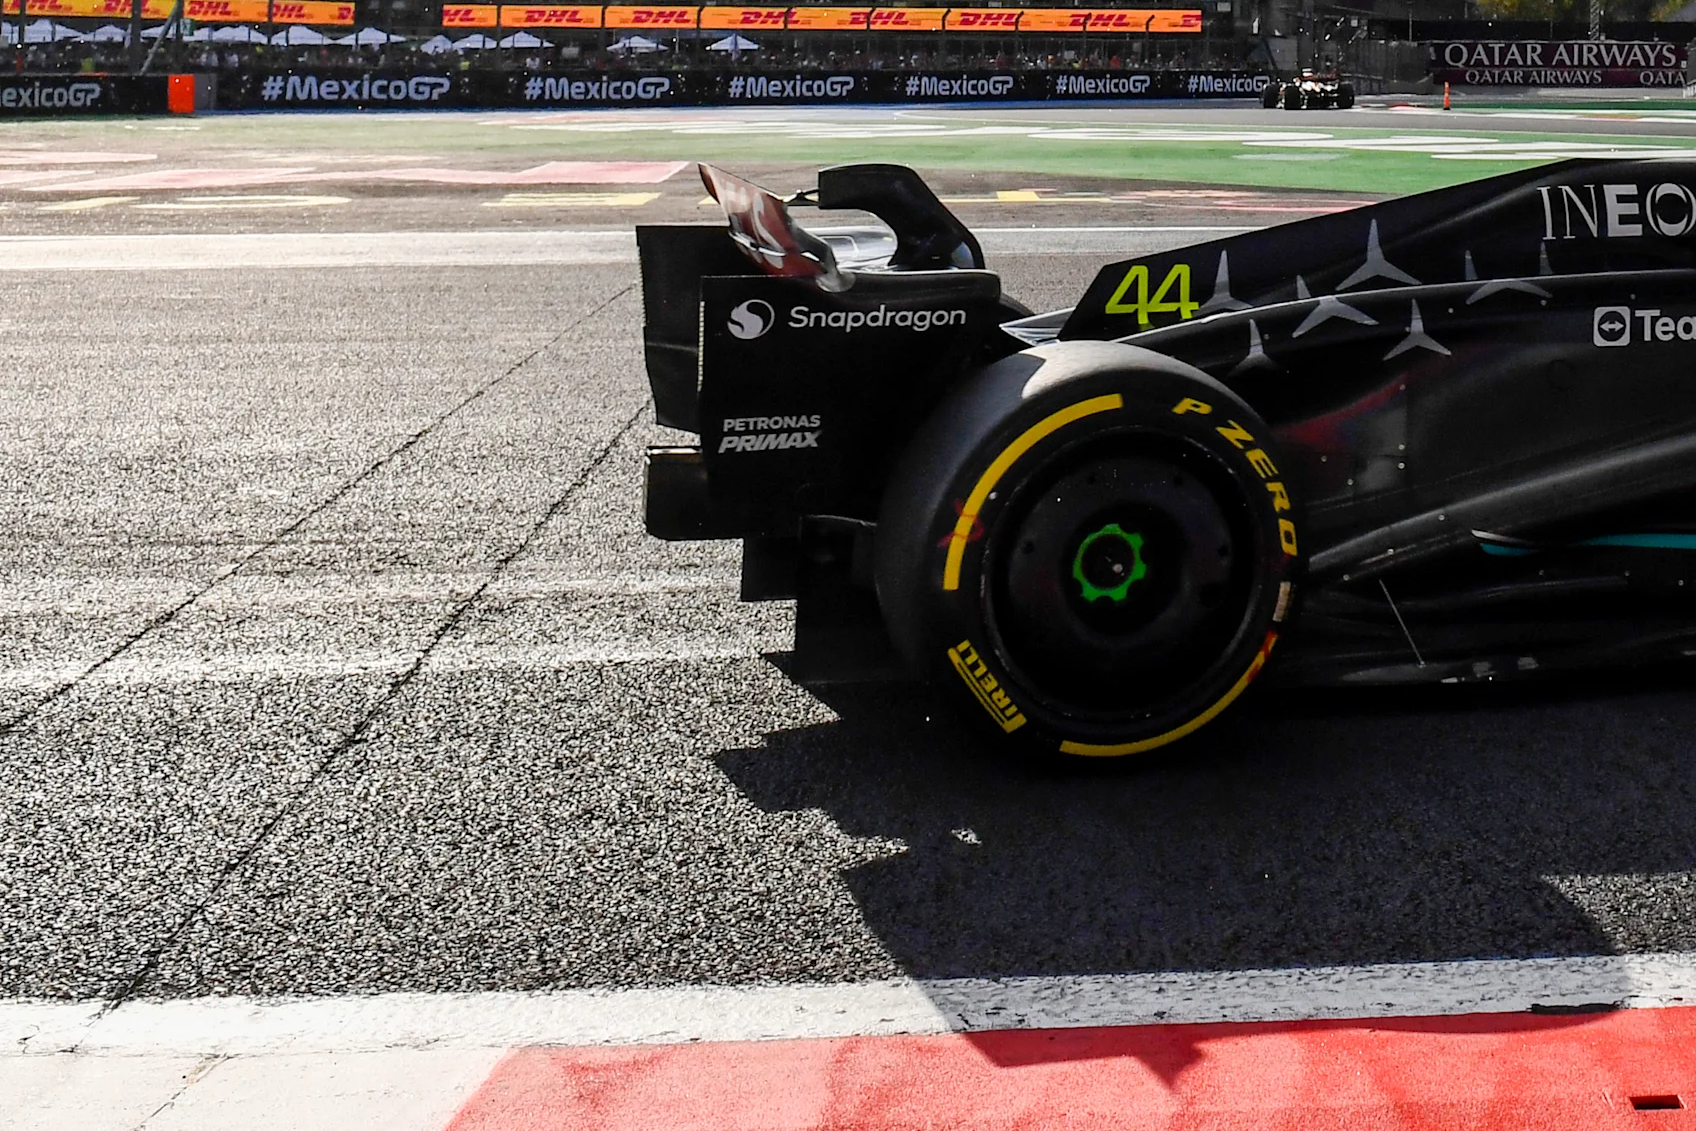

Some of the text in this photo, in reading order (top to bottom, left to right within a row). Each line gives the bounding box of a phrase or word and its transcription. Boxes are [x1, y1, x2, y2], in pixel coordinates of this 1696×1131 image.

[188, 0, 231, 17] DHL
[443, 9, 476, 22] HL
[525, 10, 583, 23] DHL
[631, 10, 691, 24] DHL
[739, 10, 800, 24] DHL
[849, 11, 909, 26] DHL
[1069, 13, 1130, 27] DHL
[1444, 44, 1676, 68] QATAR AIRWAYS
[262, 74, 450, 101] #MexicoGP
[524, 74, 671, 101] #MexicoGP
[728, 75, 854, 98] #MexicoGP
[905, 74, 1014, 96] #MexicoGP
[1055, 74, 1151, 95] #MexicoGP
[1465, 70, 1603, 85] QATAR AIRWAYS
[0, 82, 101, 107] exicoGP
[1105, 264, 1200, 324] 44
[788, 304, 967, 334] Snapdragon
[722, 415, 821, 432] PETRONAS
[718, 430, 822, 454] PRIMAX
[1172, 397, 1298, 557] P ZERO
[947, 639, 1028, 733] PIRELLI
